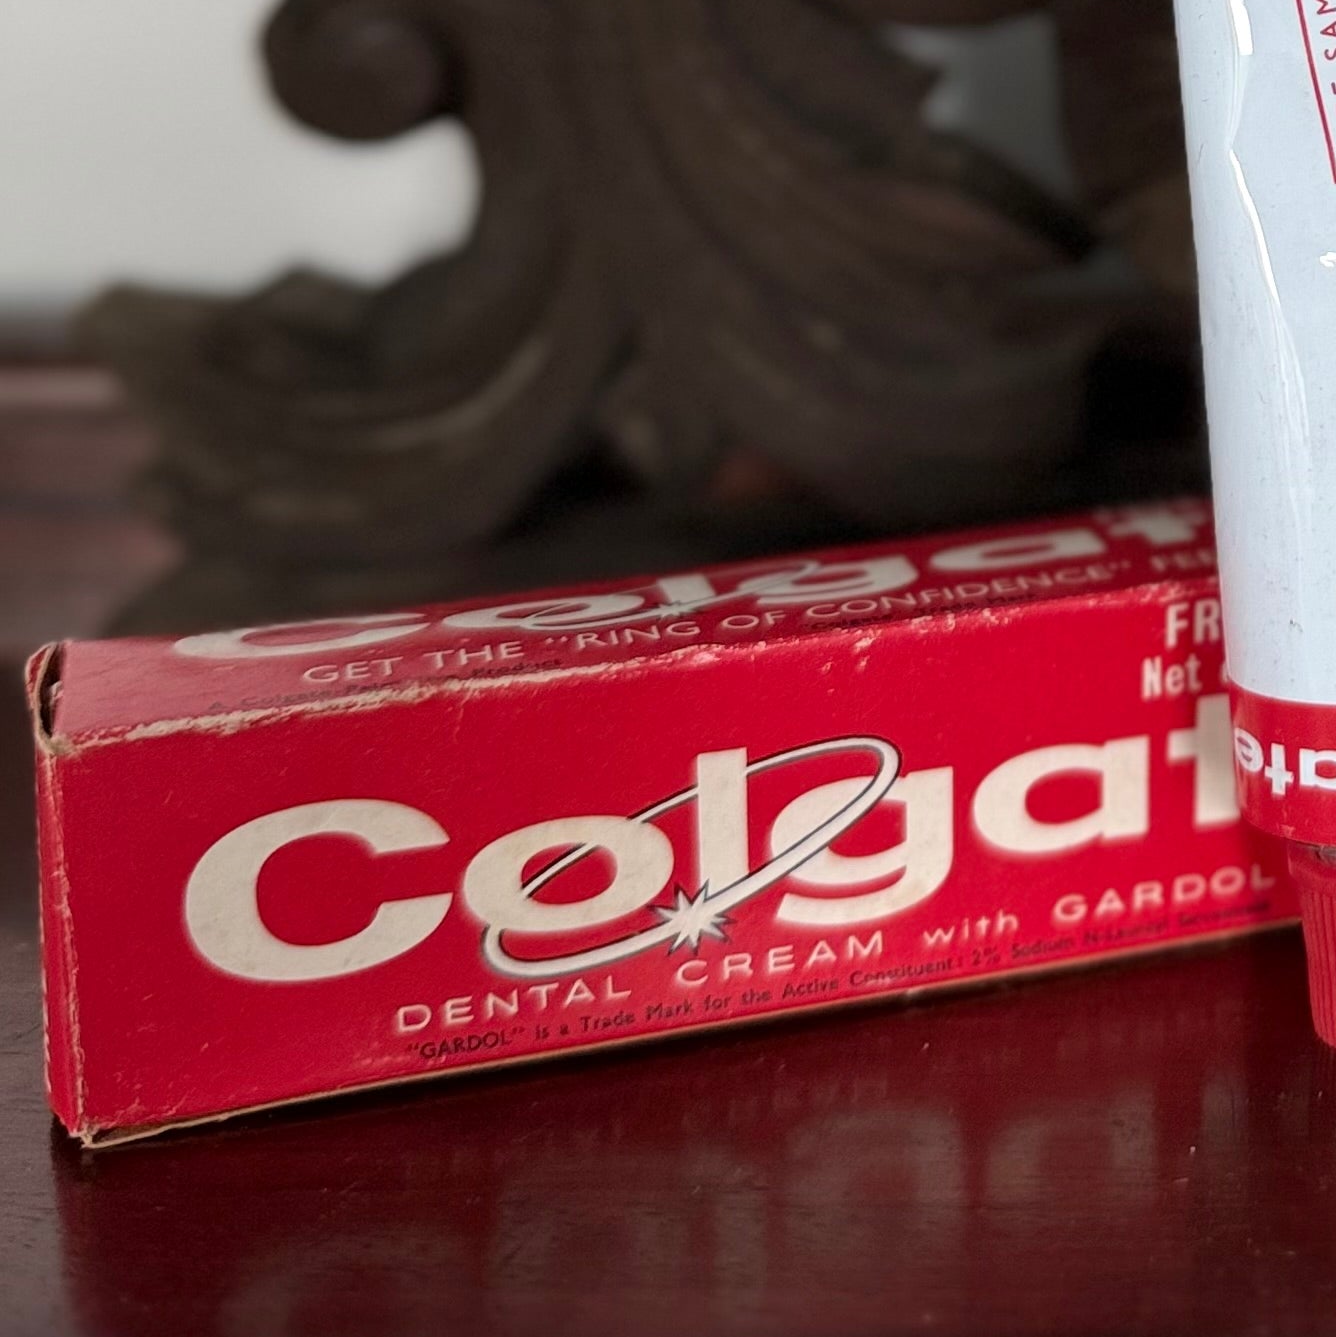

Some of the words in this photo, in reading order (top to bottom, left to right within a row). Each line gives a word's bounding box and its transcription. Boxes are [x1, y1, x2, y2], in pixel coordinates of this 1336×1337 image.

[174, 512, 1202, 658] Colgat
[302, 656, 403, 683] GET
[421, 640, 526, 670] THE
[544, 620, 701, 651] "RING
[720, 610, 786, 631] OF
[1141, 654, 1203, 702] Net
[183, 694, 1242, 982] Colgat
[395, 975, 633, 1032] DENTAL
[674, 930, 884, 986] CREAM
[922, 909, 1019, 948] with
[1052, 863, 1276, 924] GARDOL
[406, 1025, 526, 1060] "GARDOL"
[534, 1023, 549, 1041] is
[559, 1025, 571, 1037] a
[580, 1012, 637, 1034] Trade
[645, 999, 694, 1022] Mark
[703, 989, 732, 1013] for
[740, 987, 772, 1007] the
[781, 973, 841, 1000] Active
